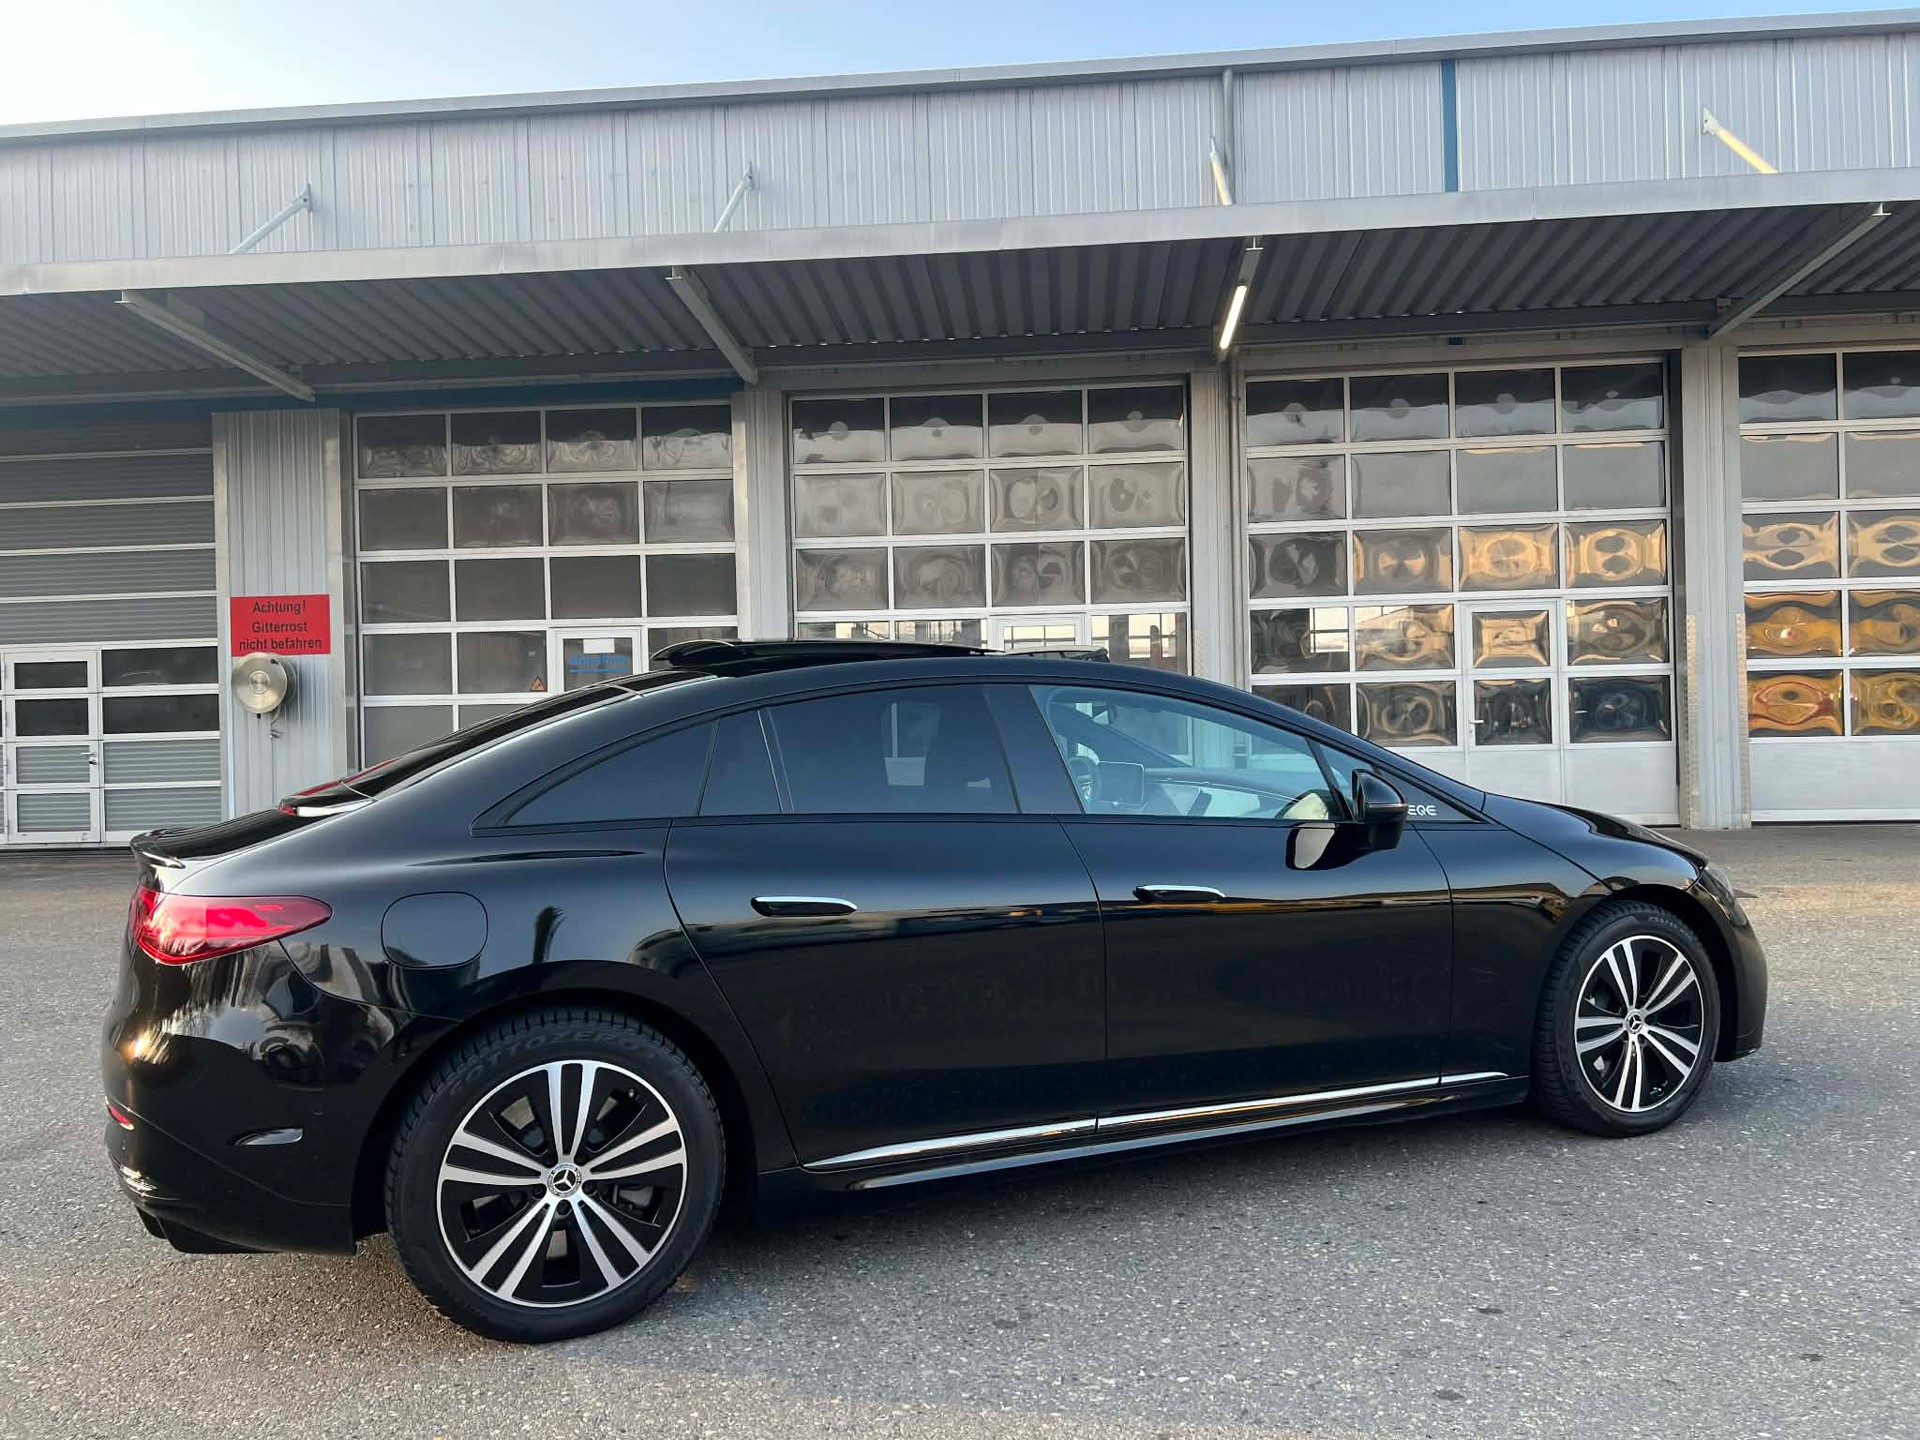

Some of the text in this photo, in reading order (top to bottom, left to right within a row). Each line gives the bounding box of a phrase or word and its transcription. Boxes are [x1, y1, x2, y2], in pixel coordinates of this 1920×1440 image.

[253, 600, 306, 615] Achtung!
[251, 621, 308, 633] Gitterrost
[240, 637, 322, 651] nicht befahren
[1407, 804, 1437, 816] EQE
